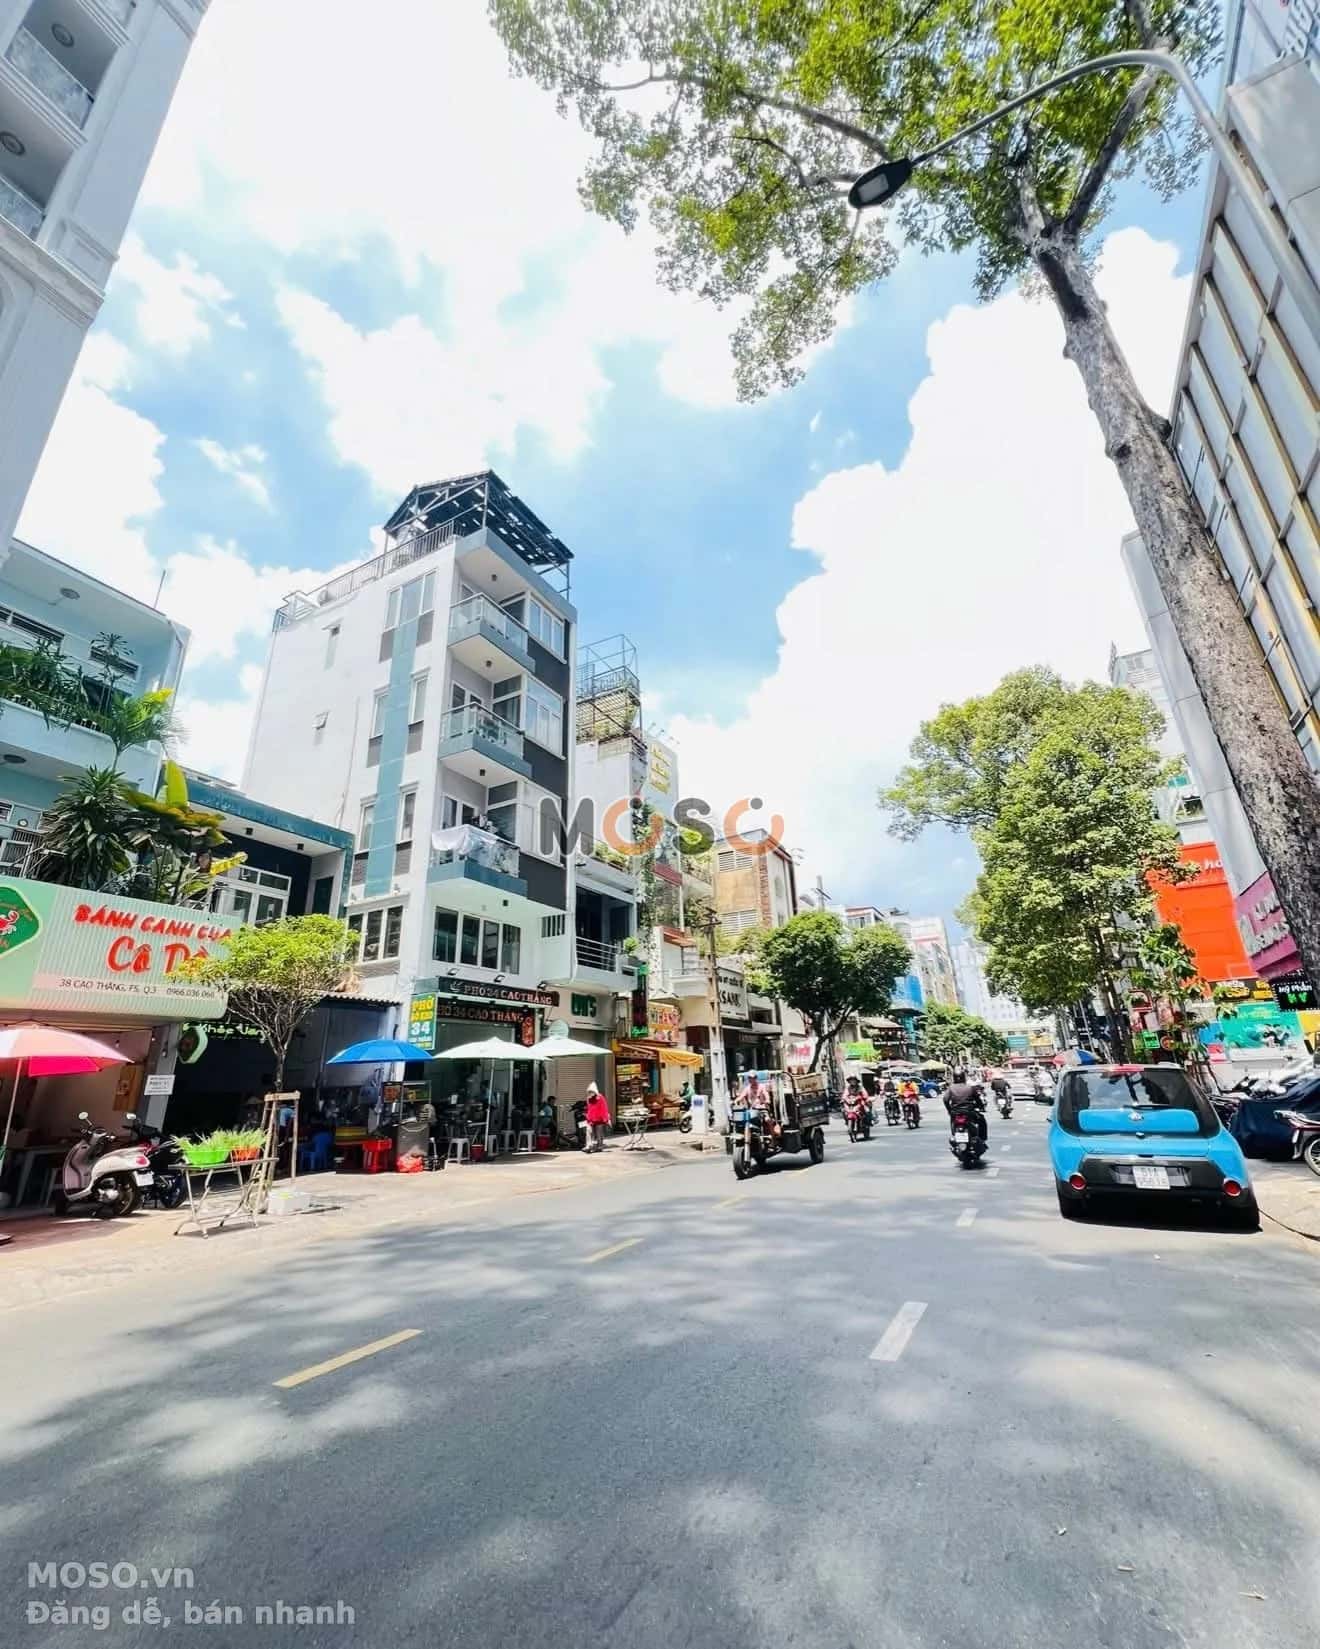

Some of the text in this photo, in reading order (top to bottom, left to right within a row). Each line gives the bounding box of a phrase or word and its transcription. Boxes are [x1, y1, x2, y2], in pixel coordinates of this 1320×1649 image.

[74, 903, 138, 929] BÁNH
[140, 915, 195, 937] CANH
[106, 935, 152, 974] Cô
[59, 978, 72, 988] 38
[73, 979, 94, 990] CAO
[410, 1021, 430, 1036] 34
